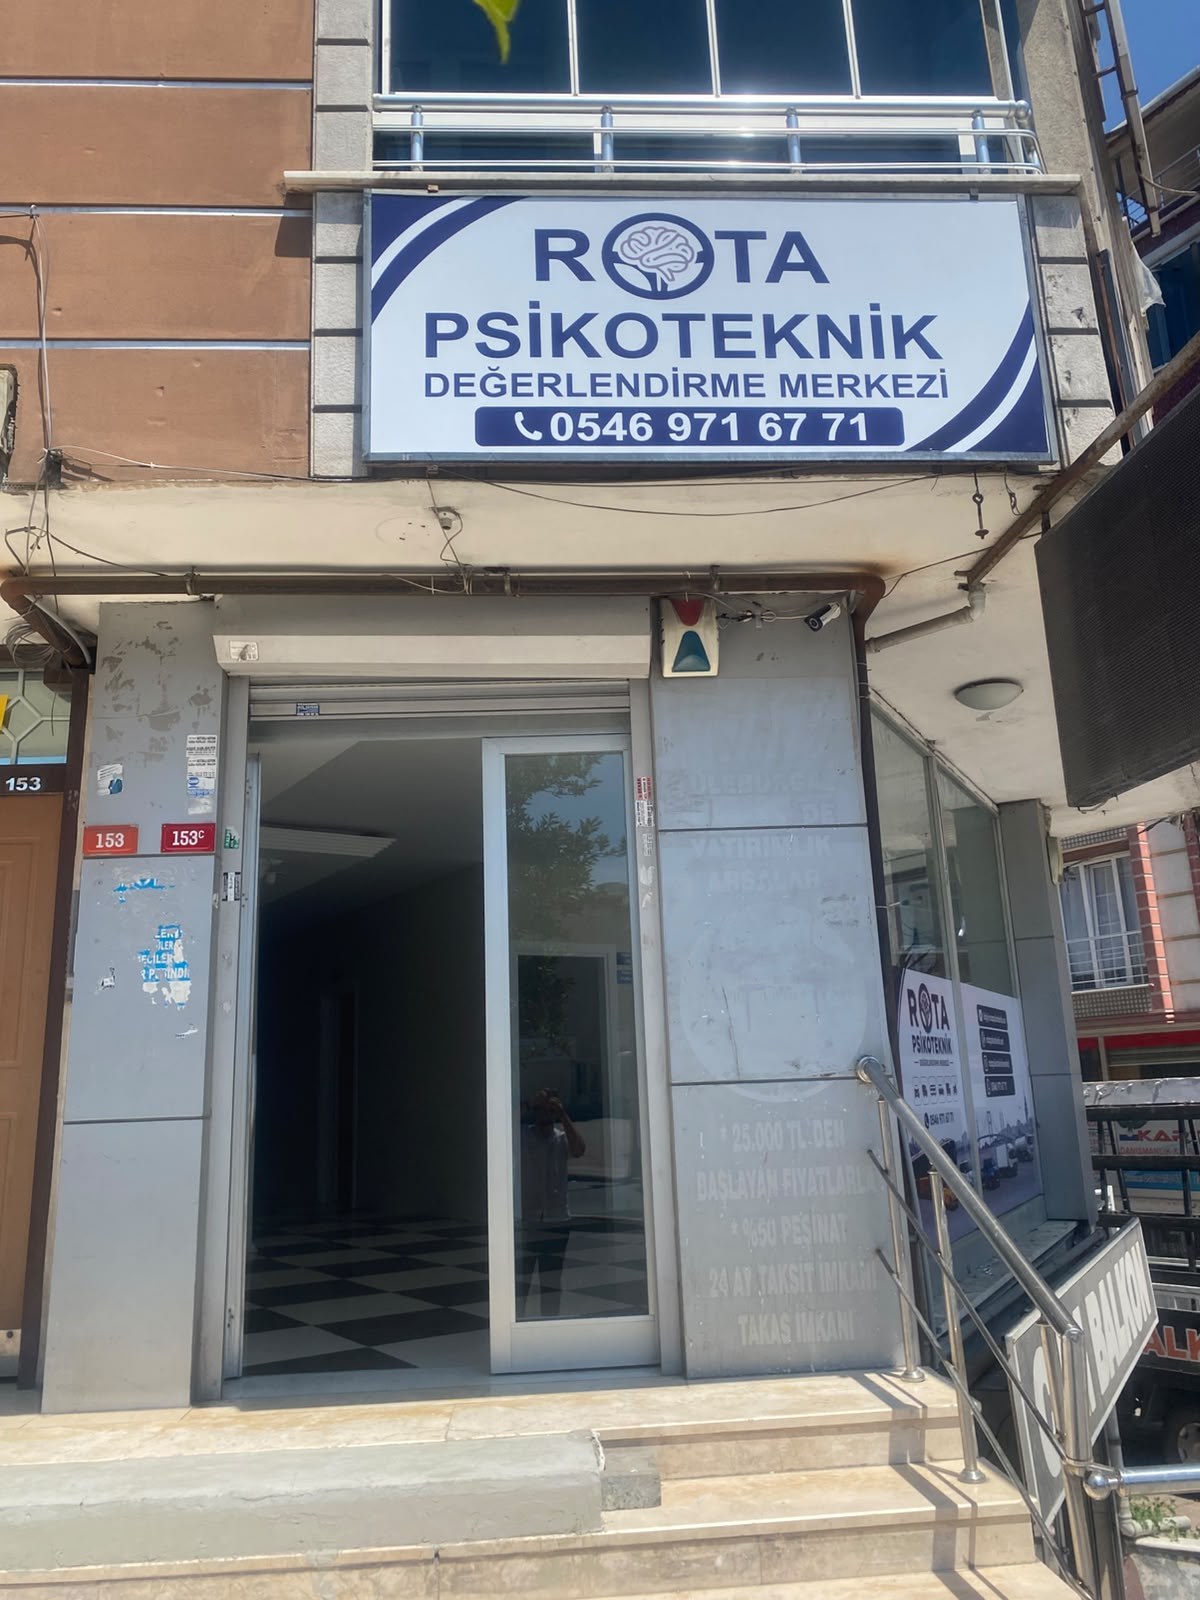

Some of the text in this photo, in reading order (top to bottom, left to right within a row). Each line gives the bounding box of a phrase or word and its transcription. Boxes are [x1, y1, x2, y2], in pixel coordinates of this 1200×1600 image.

[535, 212, 830, 300] ROTA
[424, 300, 944, 360] PSİKOTEKNİK
[424, 366, 949, 399] DEĞERLENDİRME MERKEZİ
[549, 410, 869, 443] 0546 971 67 71
[5, 776, 42, 792] 153
[95, 832, 125, 849] 153
[907, 983, 950, 1034] ROTA
[911, 1032, 953, 1056] PSİKOTEKNİK
[1085, 1241, 1152, 1396] BALKON
